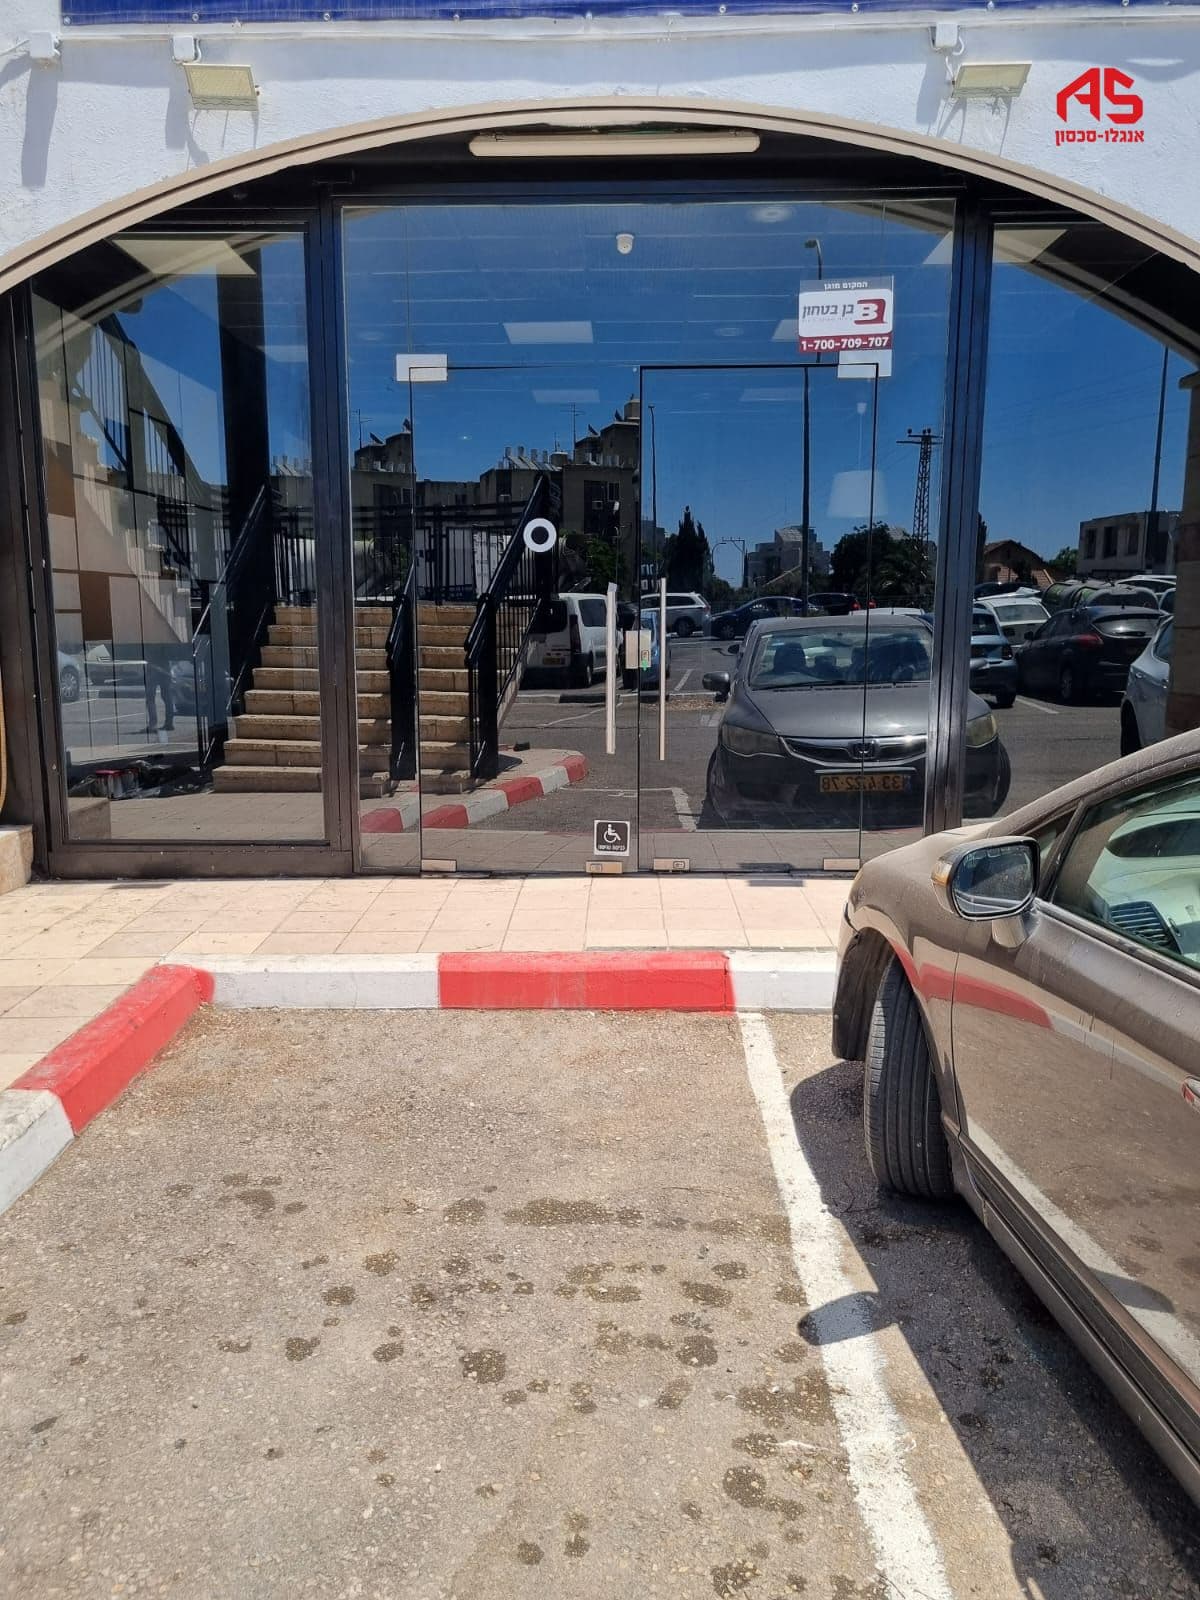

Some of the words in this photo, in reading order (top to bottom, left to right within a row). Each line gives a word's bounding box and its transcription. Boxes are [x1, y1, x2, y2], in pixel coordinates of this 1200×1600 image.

[824, 283, 841, 291] מוגן
[842, 282, 868, 290] המקום
[802, 304, 839, 319] בטחון
[842, 303, 855, 318] בן
[801, 336, 890, 351] 1-700-709-707
